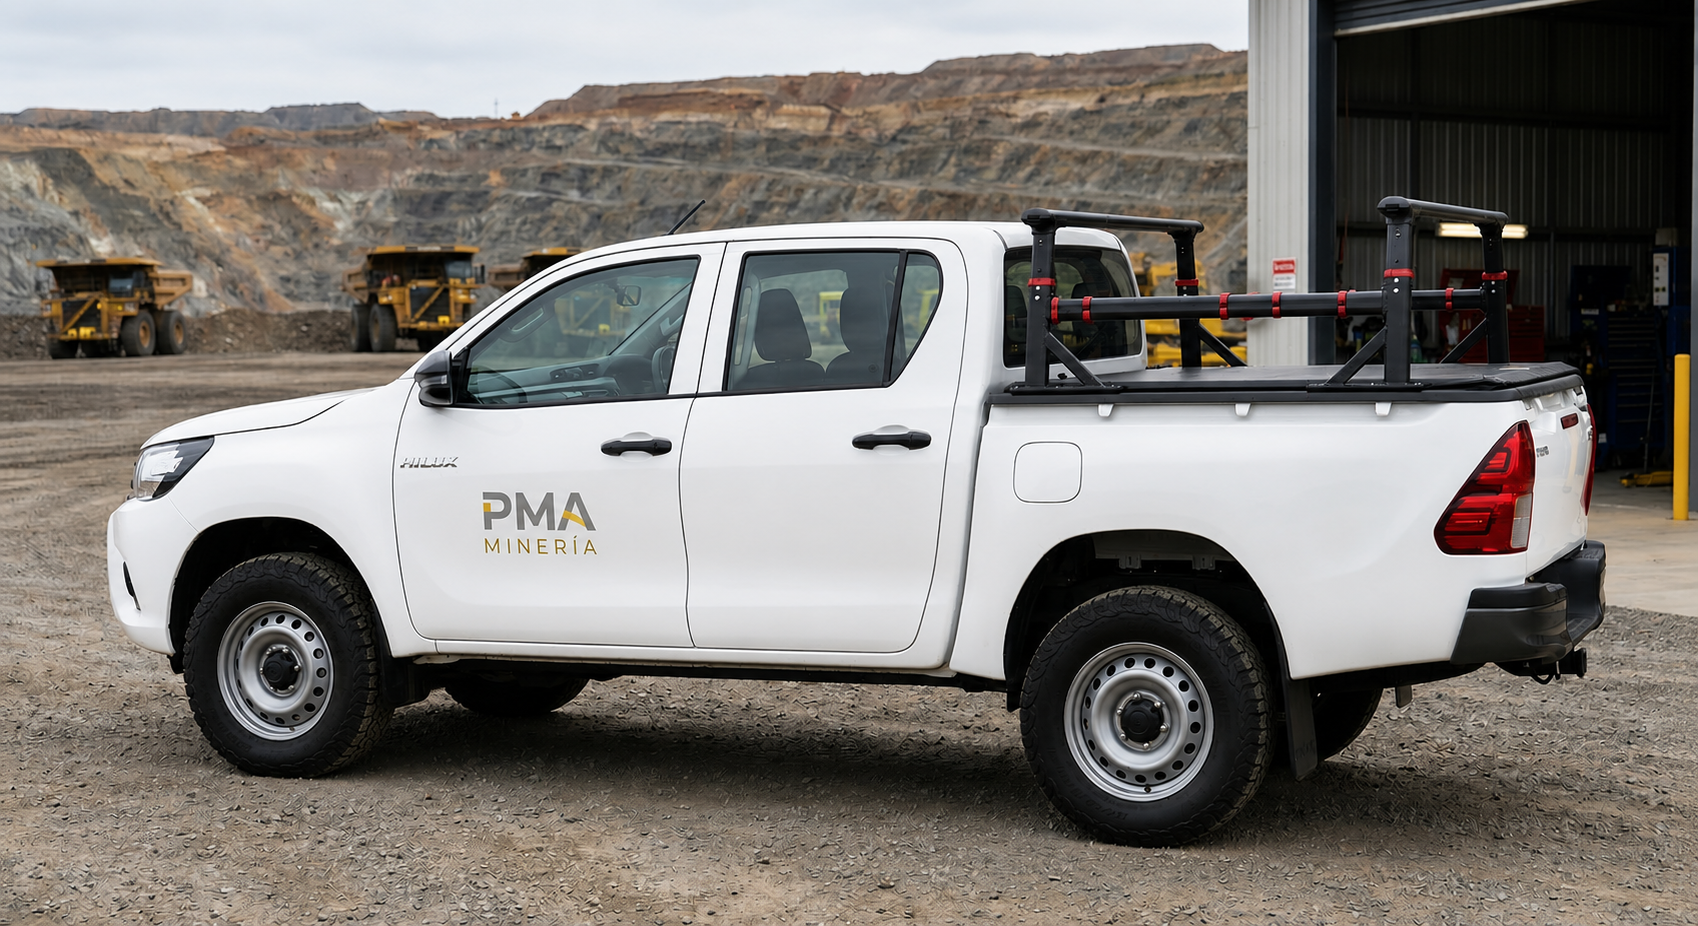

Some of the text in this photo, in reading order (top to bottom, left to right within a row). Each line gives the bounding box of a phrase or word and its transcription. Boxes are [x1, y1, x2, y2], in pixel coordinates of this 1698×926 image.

[400, 457, 459, 468] HILUX
[482, 491, 597, 531] PMA
[484, 535, 598, 555] MINERÍA
